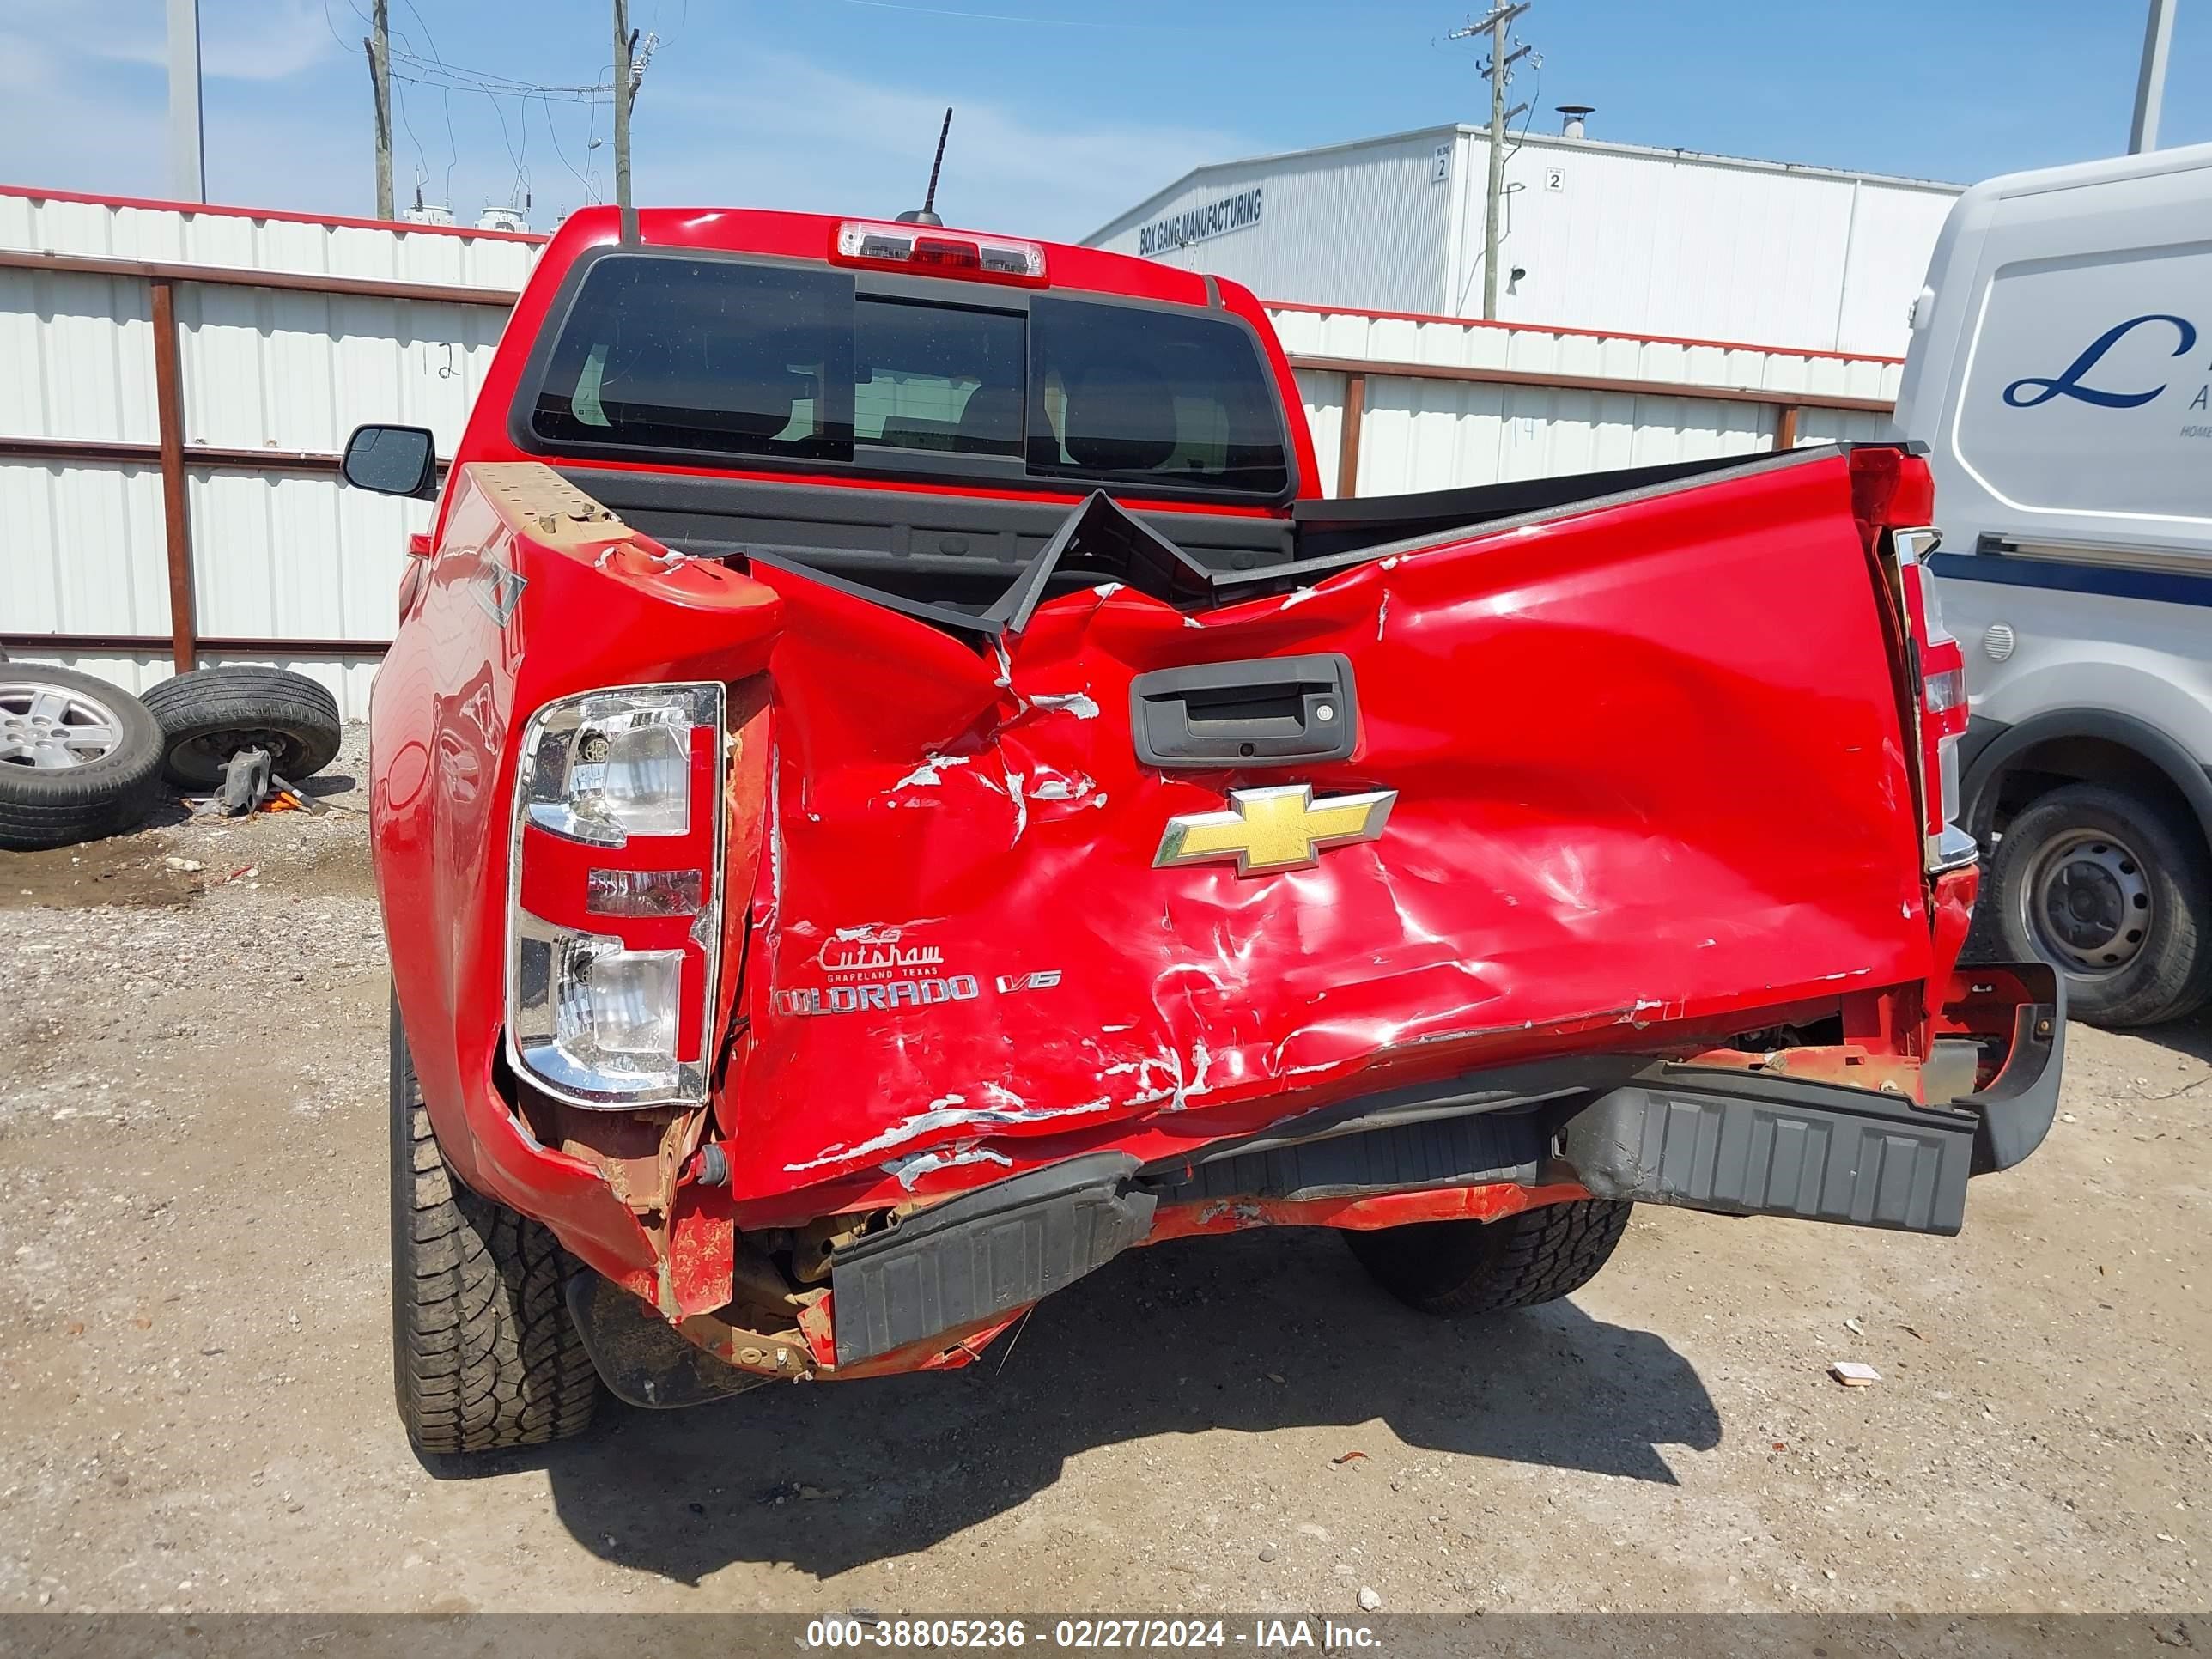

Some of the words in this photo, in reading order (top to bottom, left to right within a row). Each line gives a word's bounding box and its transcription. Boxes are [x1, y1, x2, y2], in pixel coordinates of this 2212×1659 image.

[1438, 159, 1445, 177] 2
[1550, 174, 1560, 188] 2
[1140, 225, 1157, 255] BOX
[1157, 216, 1183, 251] GANG
[1182, 188, 1261, 241] MANUFACTURING
[422, 343, 461, 379] 12
[1514, 415, 1534, 447] 14
[817, 937, 945, 971] Cutshaw
[827, 970, 894, 983] GRAPELAND
[903, 967, 939, 977] TEXAS
[774, 975, 980, 1017] COLORADO
[995, 969, 1063, 994] V6
